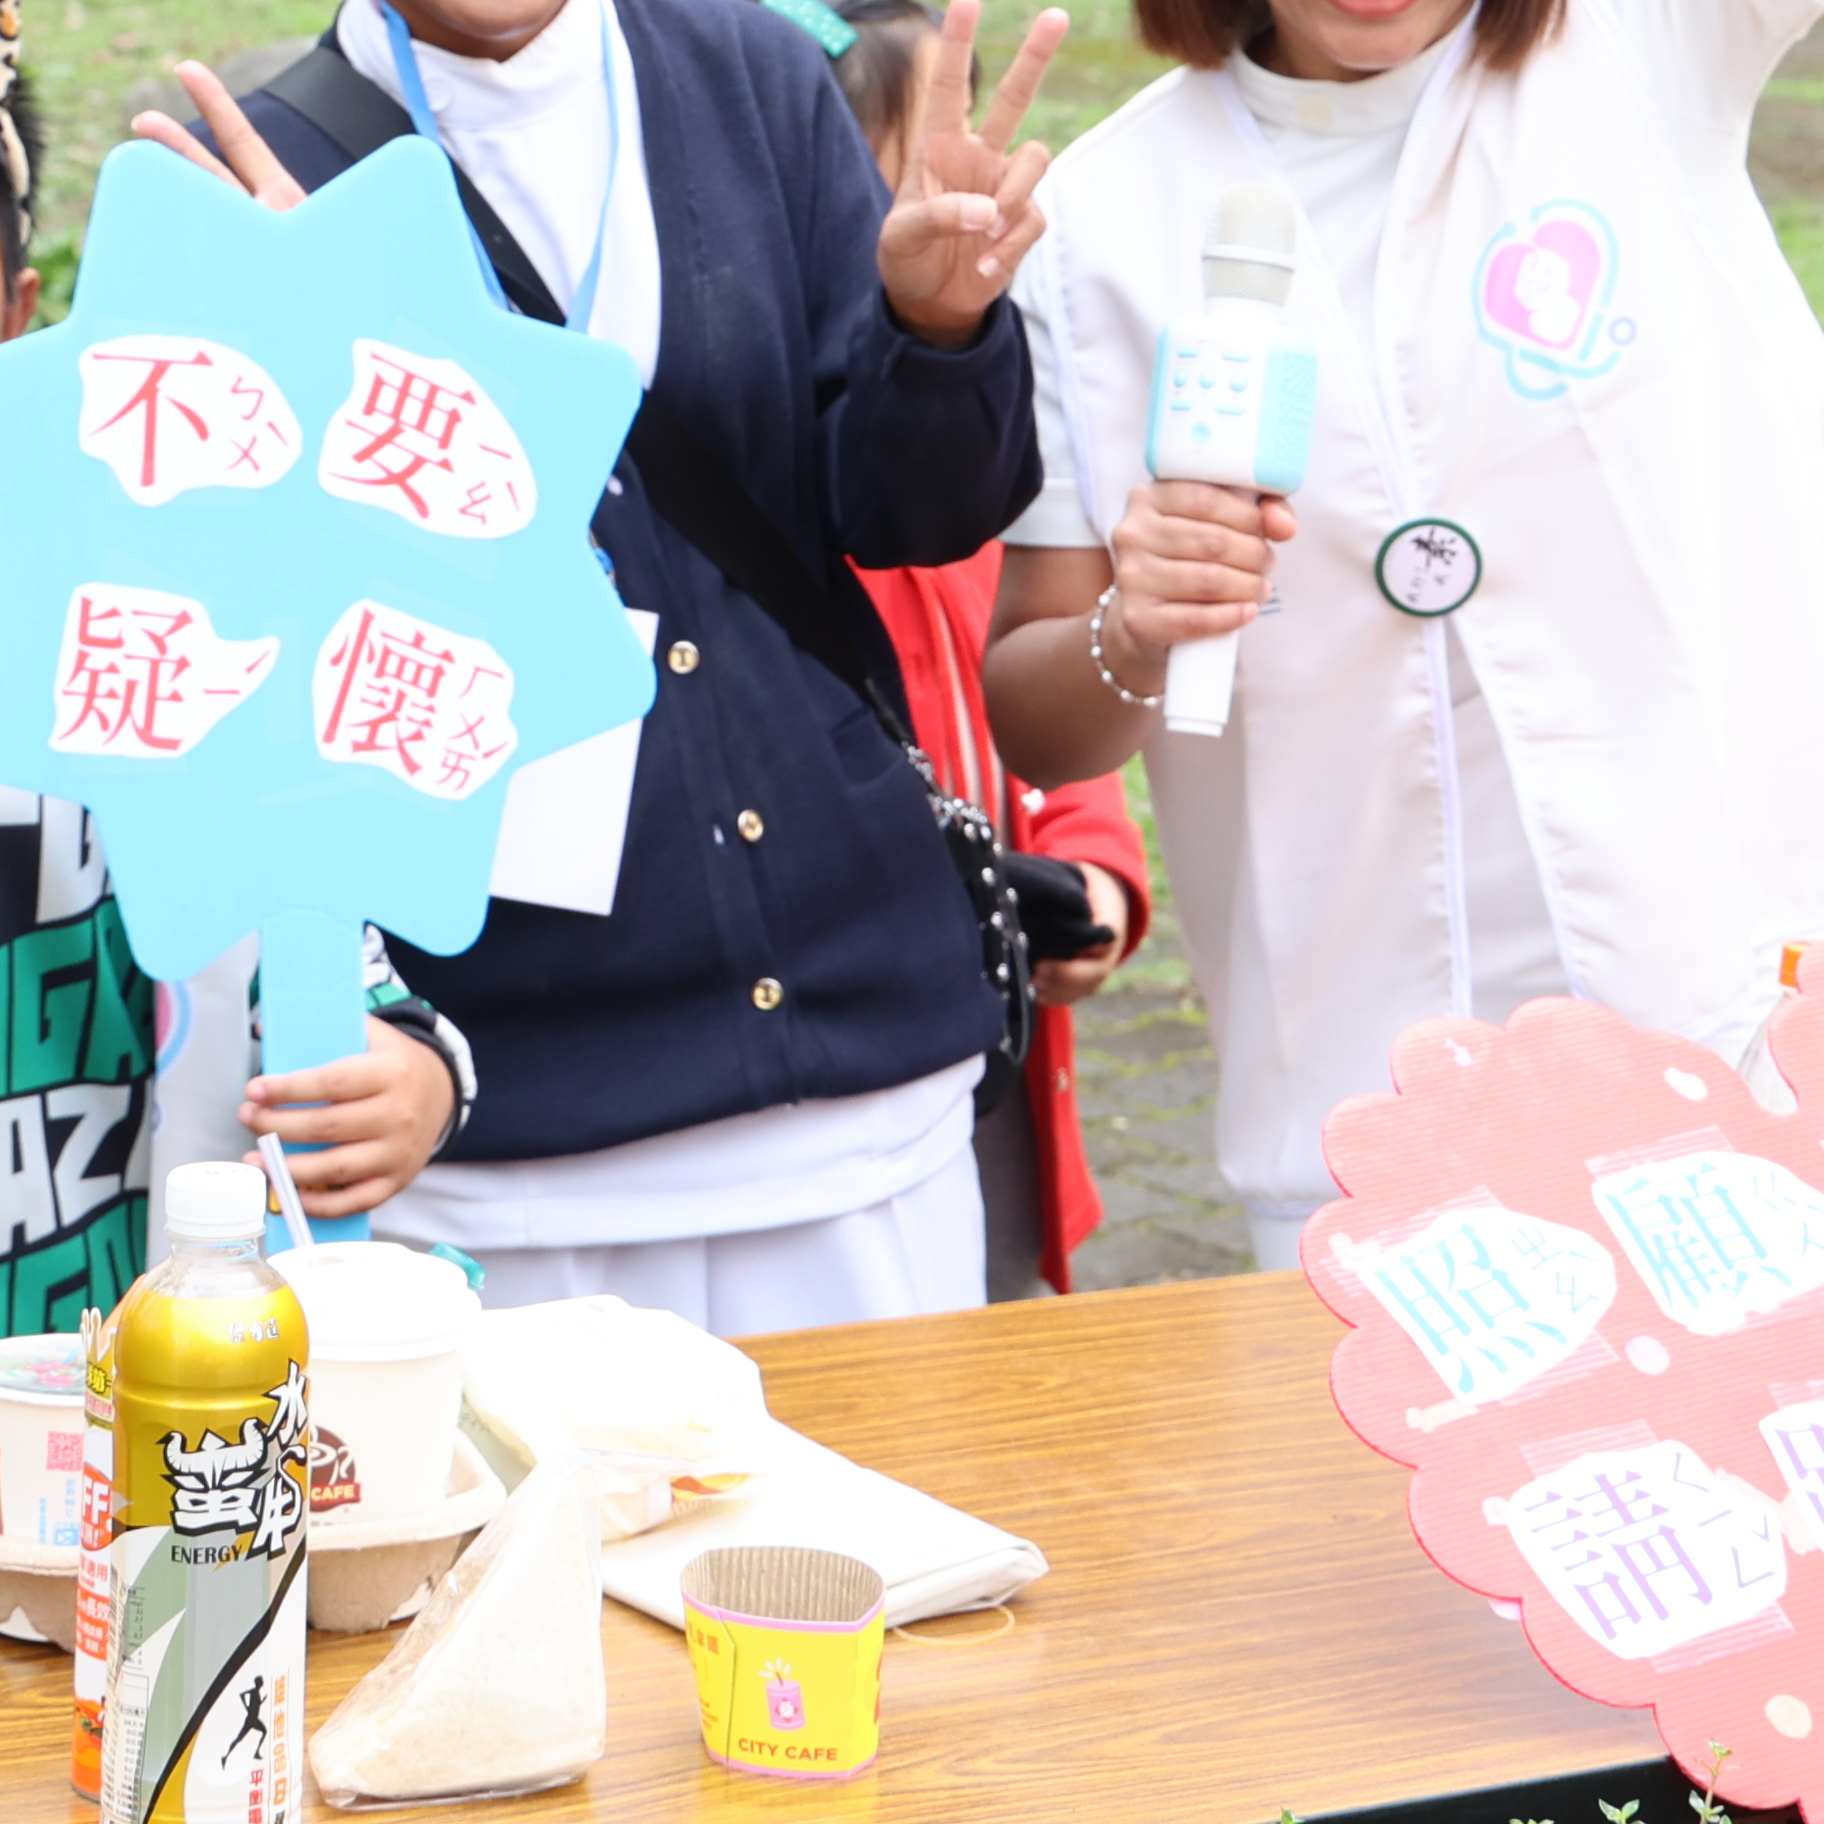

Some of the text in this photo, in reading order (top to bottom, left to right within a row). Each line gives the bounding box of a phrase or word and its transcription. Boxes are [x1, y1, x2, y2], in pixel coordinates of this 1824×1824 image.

[311, 1485, 354, 1501] CAFE
[171, 1544, 242, 1565] ENERGY
[738, 1738, 838, 1761] CITY CAFE
